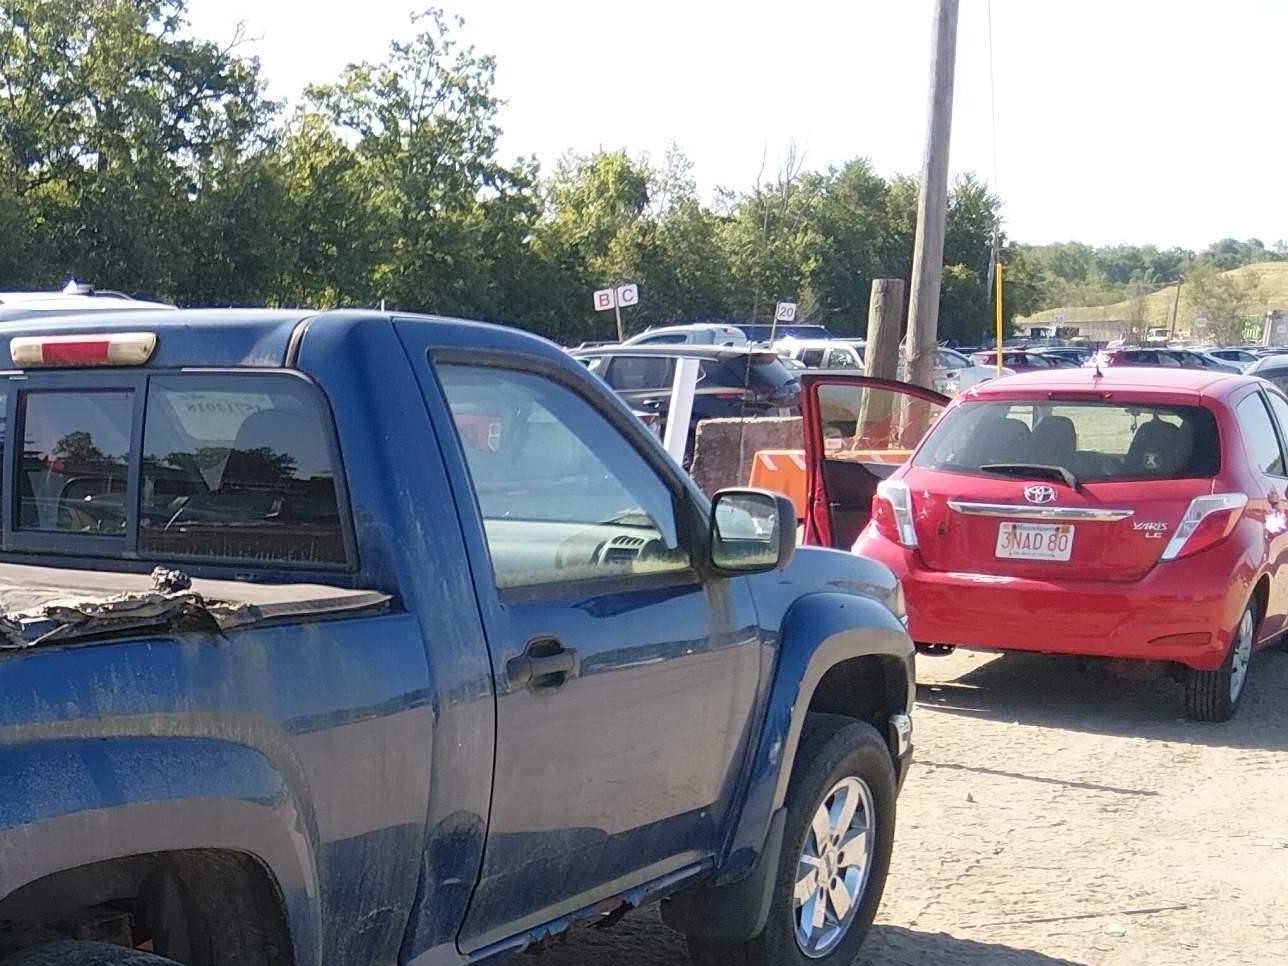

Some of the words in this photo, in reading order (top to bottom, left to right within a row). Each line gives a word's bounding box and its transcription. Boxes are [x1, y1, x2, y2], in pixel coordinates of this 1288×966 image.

[599, 294, 610, 307] B
[622, 289, 634, 302] C
[779, 306, 793, 318] 20
[1133, 522, 1168, 531] YARIS
[1001, 531, 1043, 550] 3NAD
[1047, 534, 1069, 552] 80
